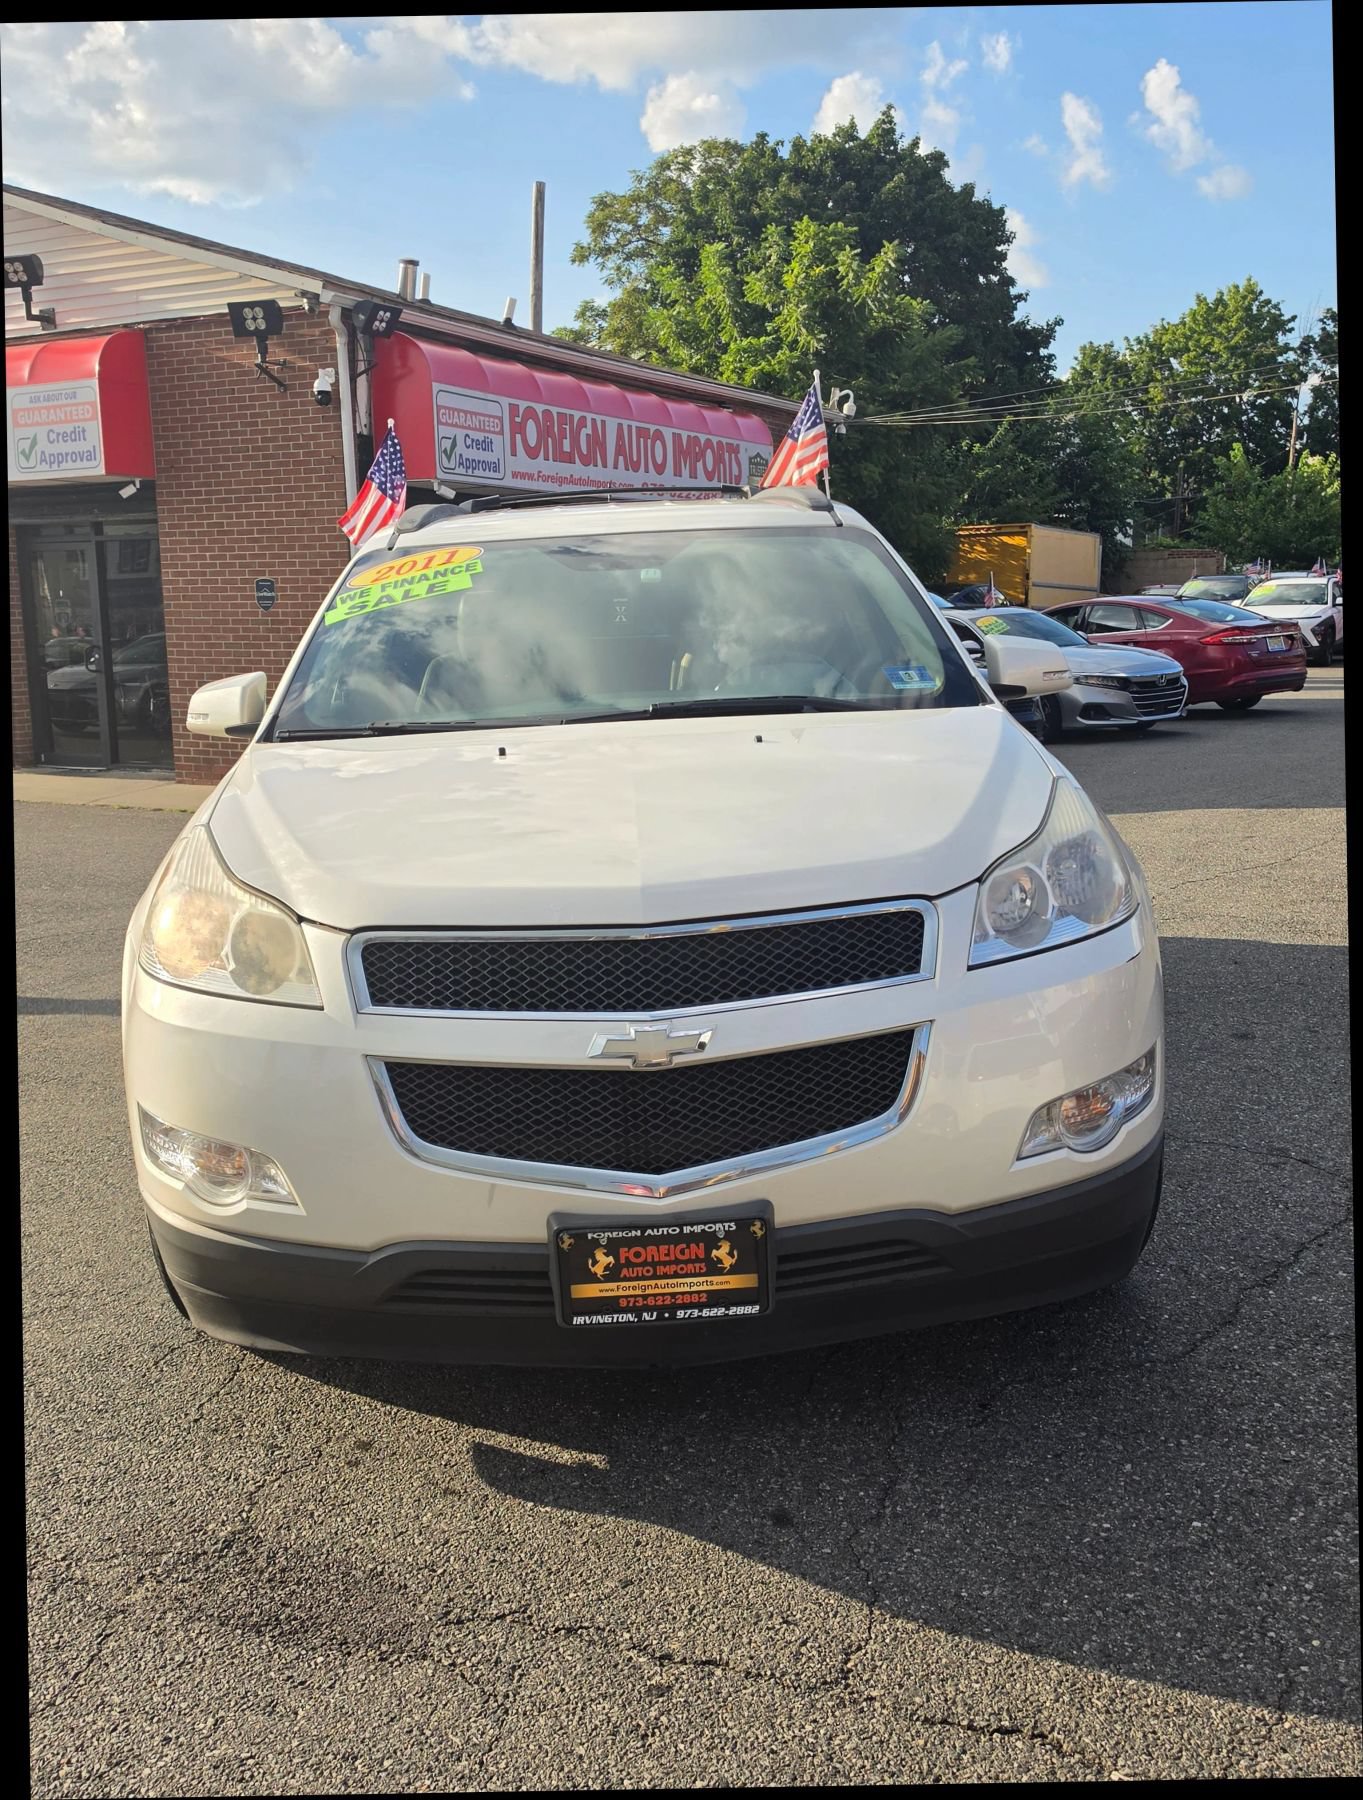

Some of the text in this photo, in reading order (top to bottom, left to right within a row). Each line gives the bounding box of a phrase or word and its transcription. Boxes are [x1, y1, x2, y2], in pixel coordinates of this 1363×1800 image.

[29, 391, 77, 404] ASK ABOUT OUR
[17, 405, 92, 425] GUARANTEED
[440, 408, 500, 431] GUARANTEED
[47, 425, 87, 444] Credit
[464, 433, 494, 453] Credit
[508, 403, 742, 486] FOREIGN AUTO IMPORTS
[39, 445, 97, 469] Approval
[458, 453, 501, 474] Approval
[370, 549, 460, 583] 2011
[339, 560, 479, 605] WE FINANCE
[343, 579, 451, 616] SALE
[588, 1222, 737, 1240] FOREIGN AUTO IMPORTS
[619, 1242, 705, 1264] FOREIGN
[620, 1262, 707, 1278] AUTO IMPORTS
[598, 1279, 731, 1293] www.ForeignAutoImports.com
[619, 1292, 708, 1307] 973-622-2882
[572, 1305, 760, 1325] IRVINGTON, NJ 973-622-2882
